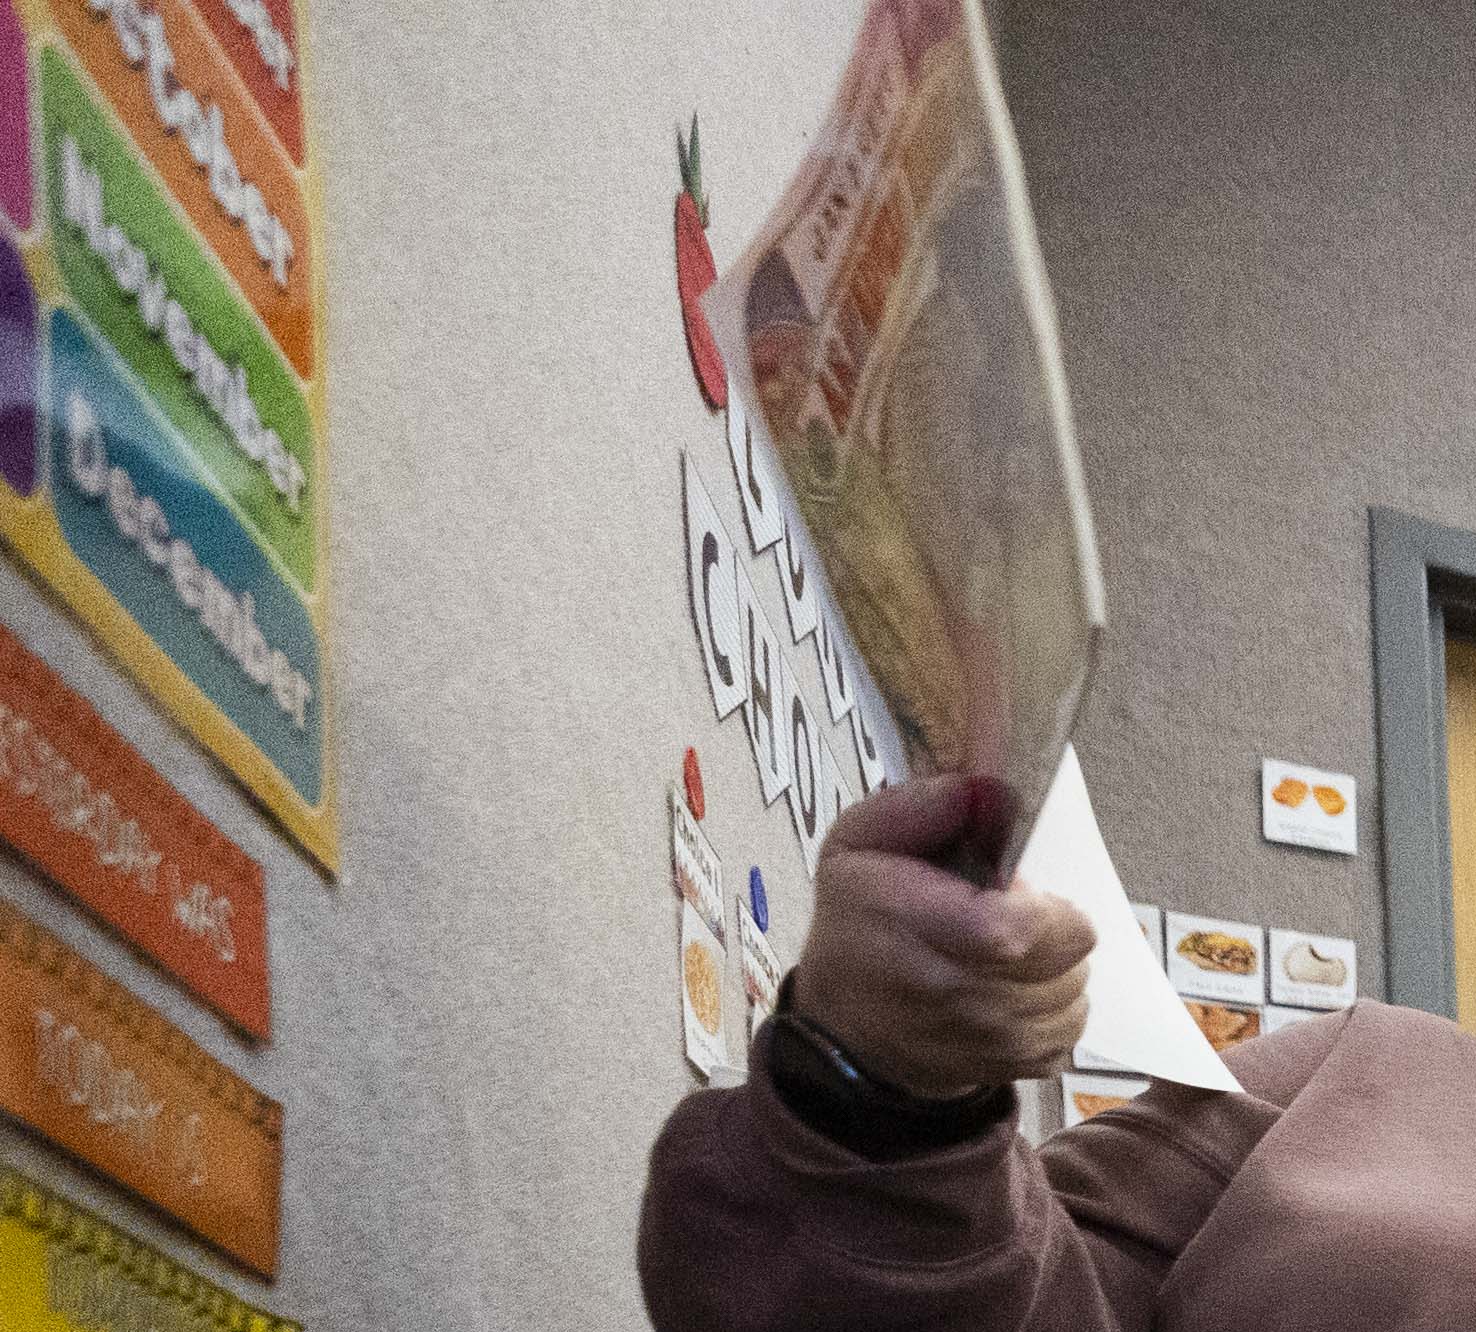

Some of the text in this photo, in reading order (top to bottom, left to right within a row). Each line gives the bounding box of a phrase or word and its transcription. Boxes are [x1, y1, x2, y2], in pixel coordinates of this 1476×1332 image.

[92, 0, 292, 287] ctober
[62, 133, 307, 508] November
[66, 392, 310, 728] December
